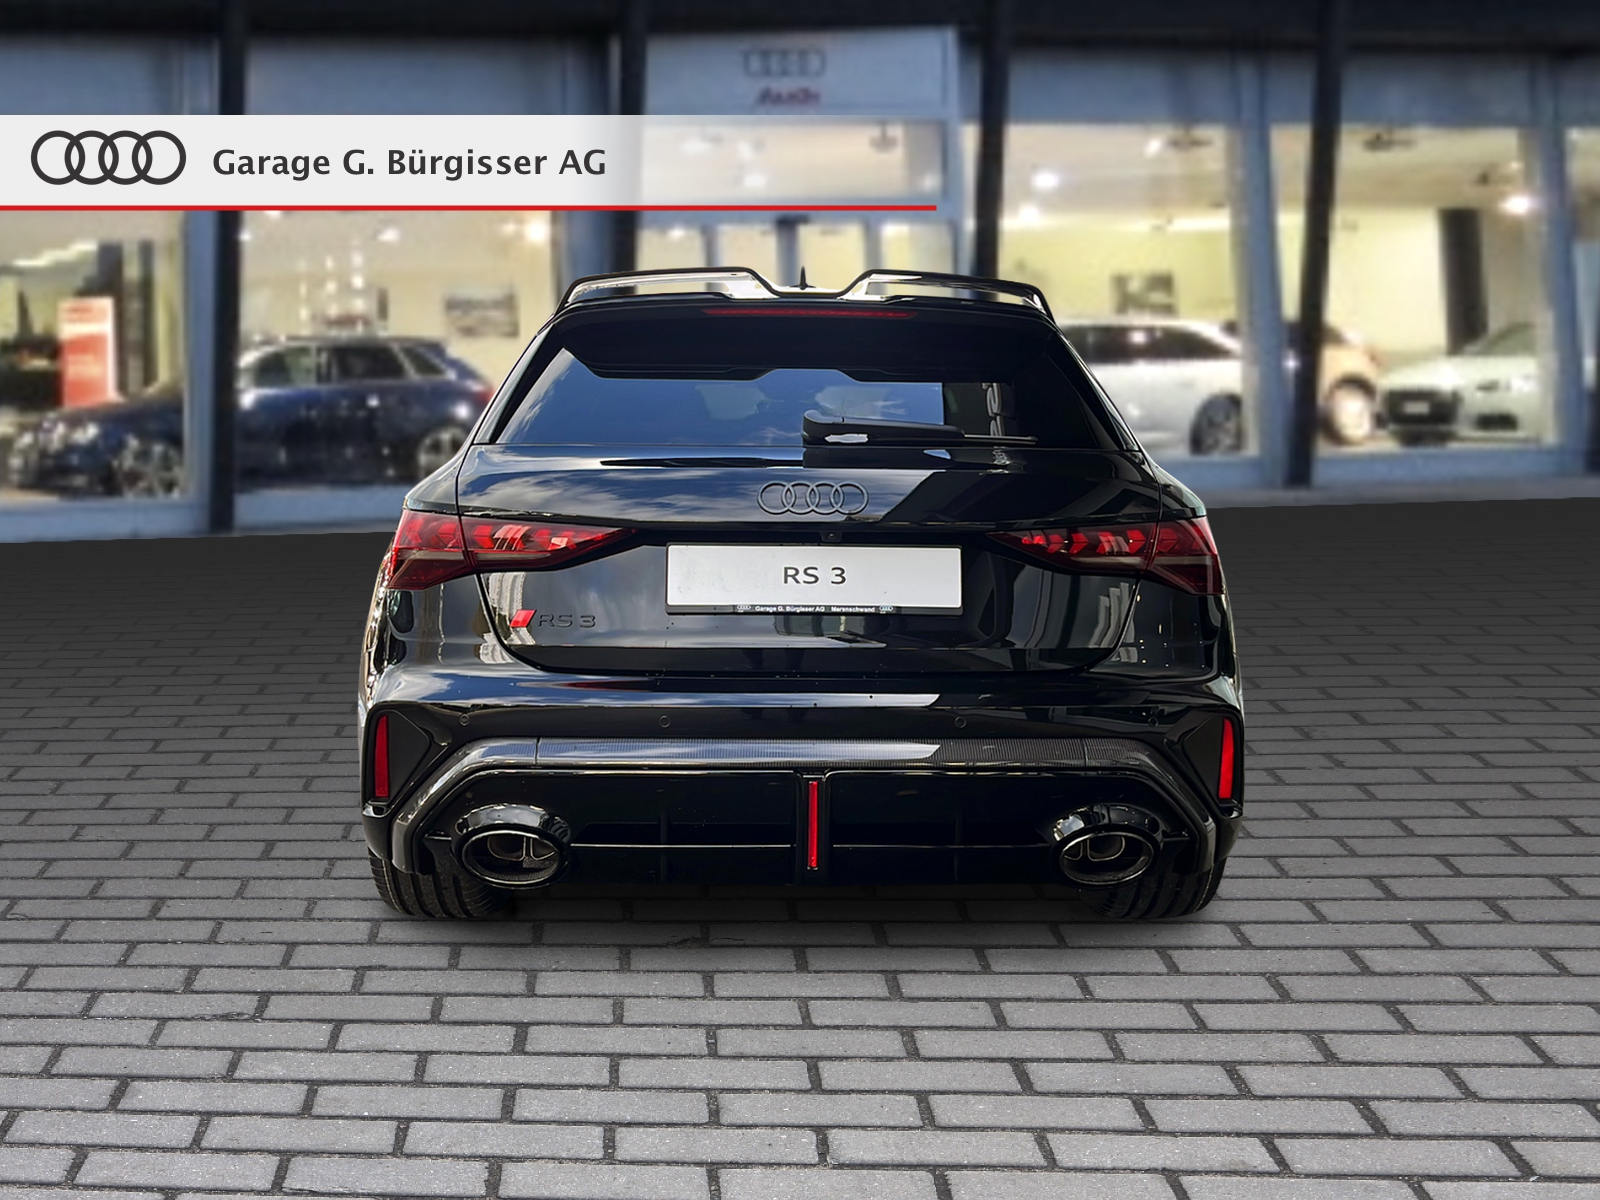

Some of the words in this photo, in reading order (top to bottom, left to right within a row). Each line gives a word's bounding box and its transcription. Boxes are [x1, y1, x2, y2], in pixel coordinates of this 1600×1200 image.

[783, 566, 819, 585] RS
[830, 566, 847, 585] 3
[755, 605, 777, 613] Garage
[538, 614, 573, 628] RS
[580, 615, 596, 628] 3
